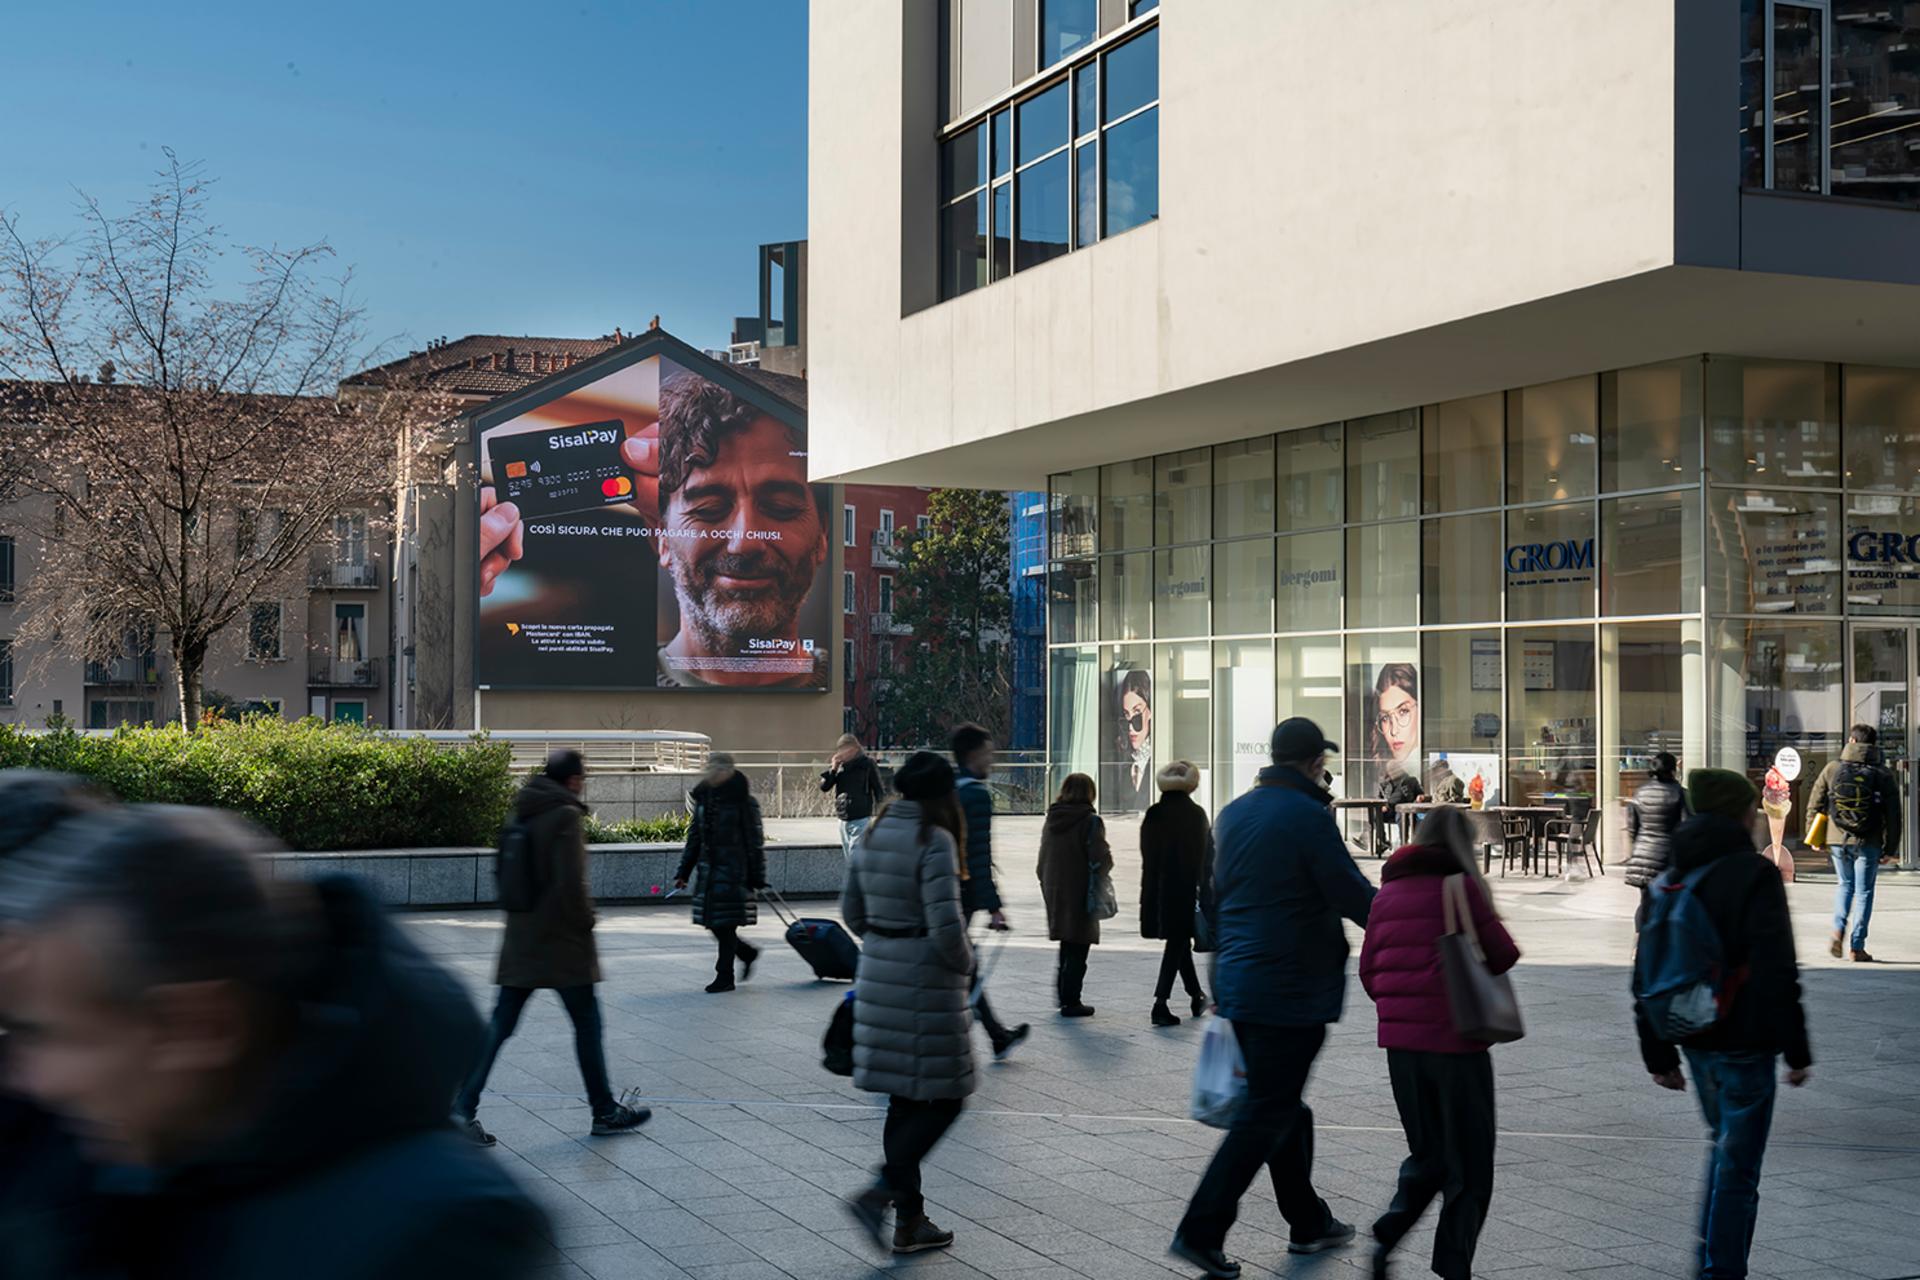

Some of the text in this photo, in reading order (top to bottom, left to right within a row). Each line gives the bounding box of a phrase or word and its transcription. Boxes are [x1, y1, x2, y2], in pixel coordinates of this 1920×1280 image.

[548, 429, 618, 450] SisalPay
[529, 523, 556, 535] COSÌ
[558, 525, 598, 536] SICURA
[601, 526, 623, 537] CHE
[626, 527, 652, 537] PUOI
[654, 528, 697, 538] PAGARE
[699, 530, 708, 539] A
[710, 530, 744, 539] OCCHI
[1504, 538, 1595, 573] GROM
[1281, 565, 1337, 589] bergomi
[748, 638, 796, 652] SisalPay
